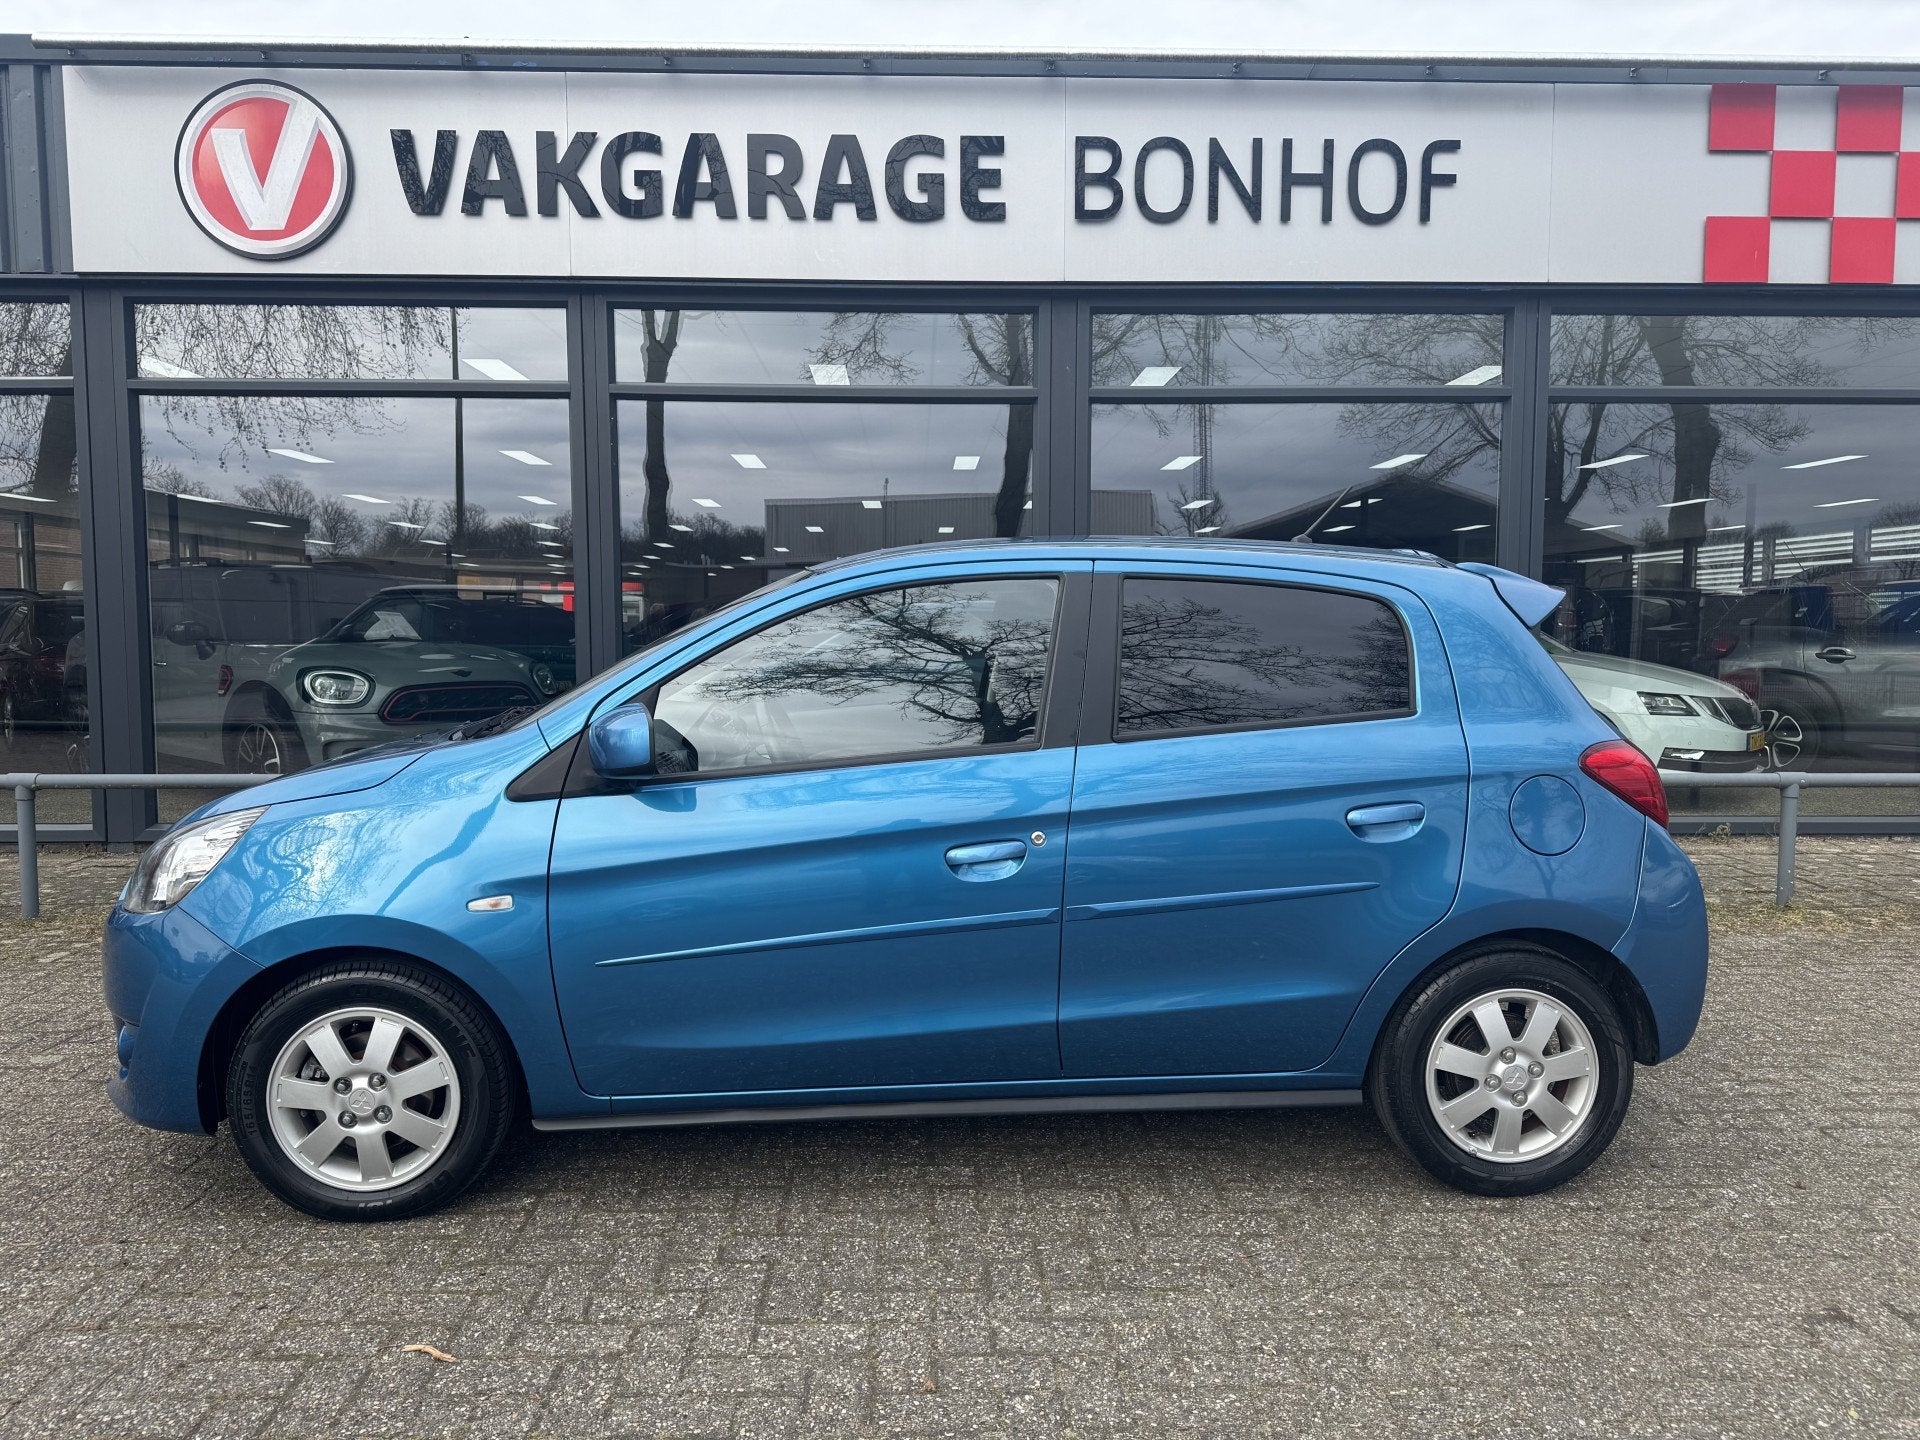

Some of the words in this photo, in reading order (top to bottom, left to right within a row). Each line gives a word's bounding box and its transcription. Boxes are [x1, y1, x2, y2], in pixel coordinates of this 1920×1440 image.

[210, 95, 325, 231] V
[389, 128, 1006, 222] VAKGARAGE
[1074, 135, 1462, 224] BONHOF
